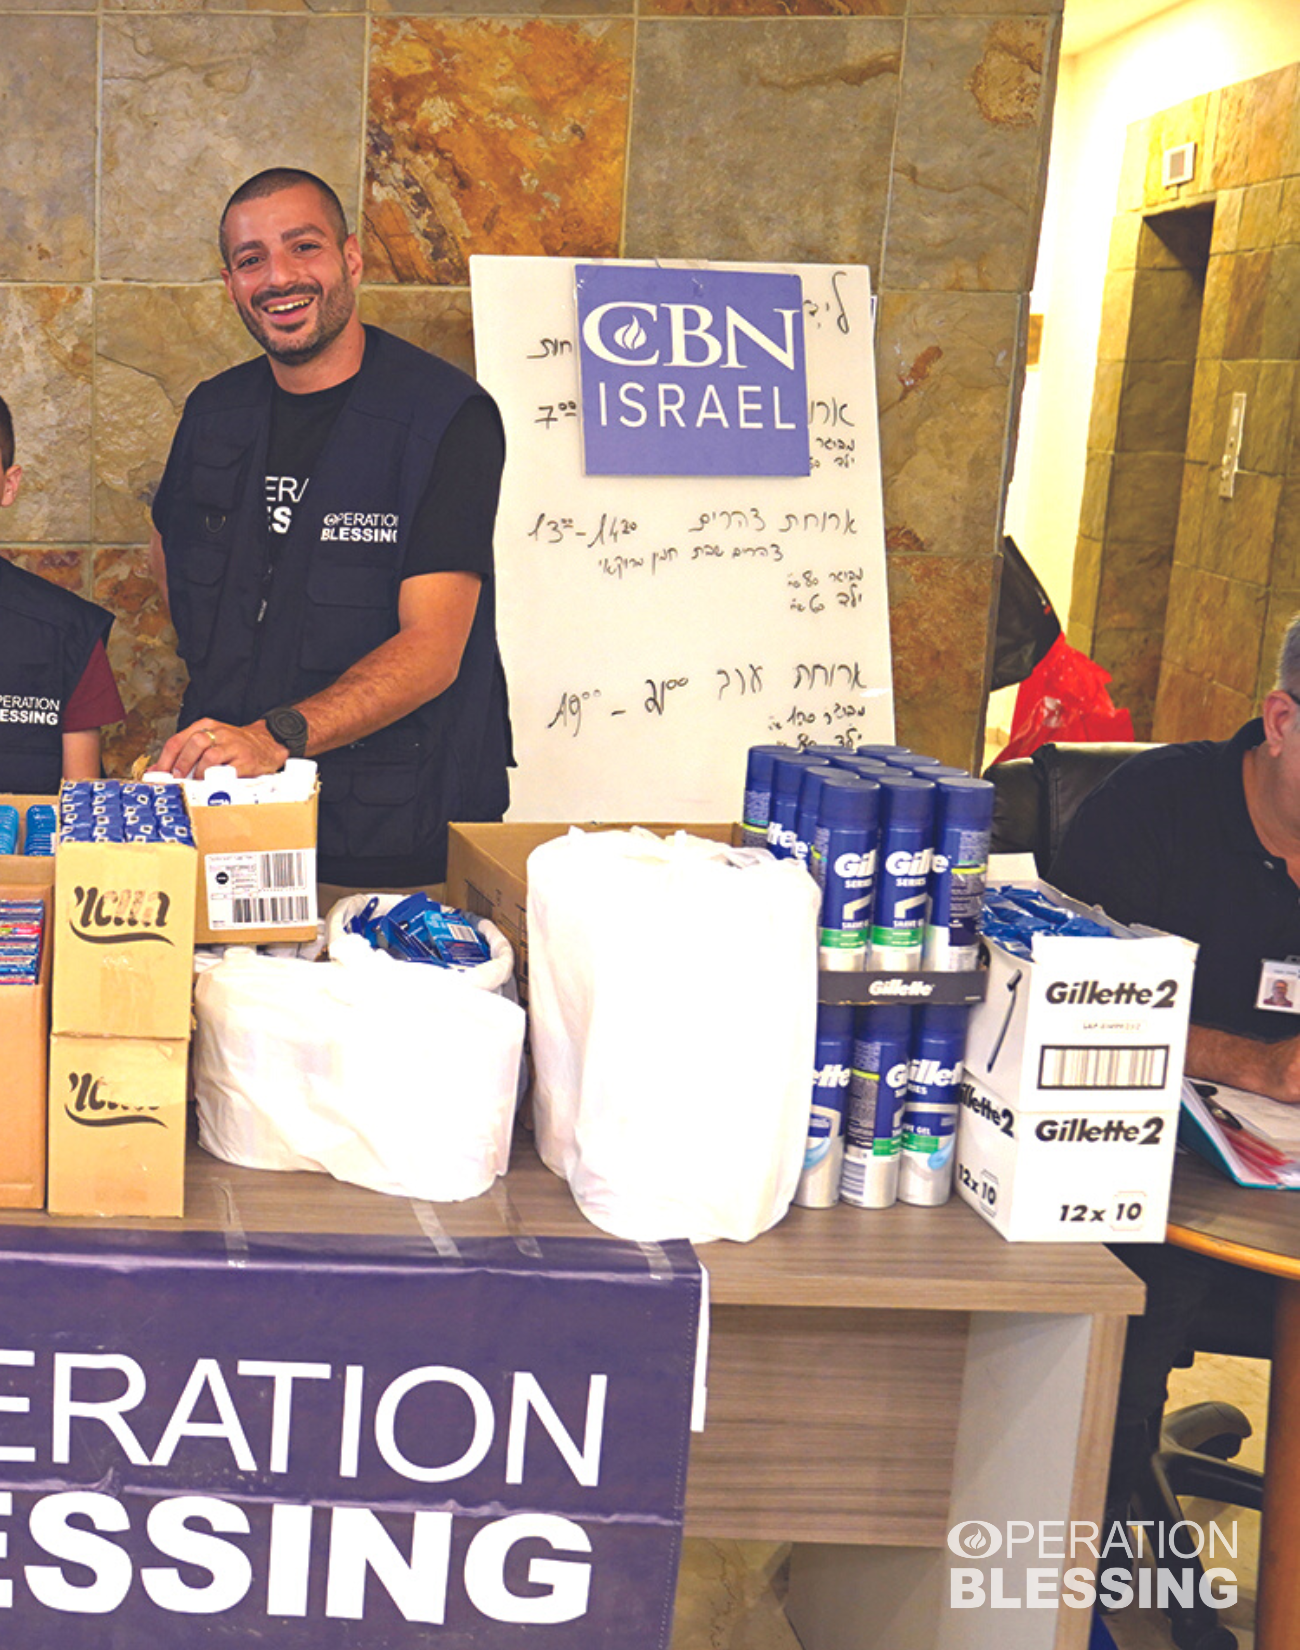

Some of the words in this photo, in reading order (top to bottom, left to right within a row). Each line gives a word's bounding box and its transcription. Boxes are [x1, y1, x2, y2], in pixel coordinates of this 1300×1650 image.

[582, 301, 800, 371] CBN
[599, 382, 797, 430] ISRAEL
[868, 979, 933, 997] Gillette
[1116, 1203, 1142, 1221] 10
